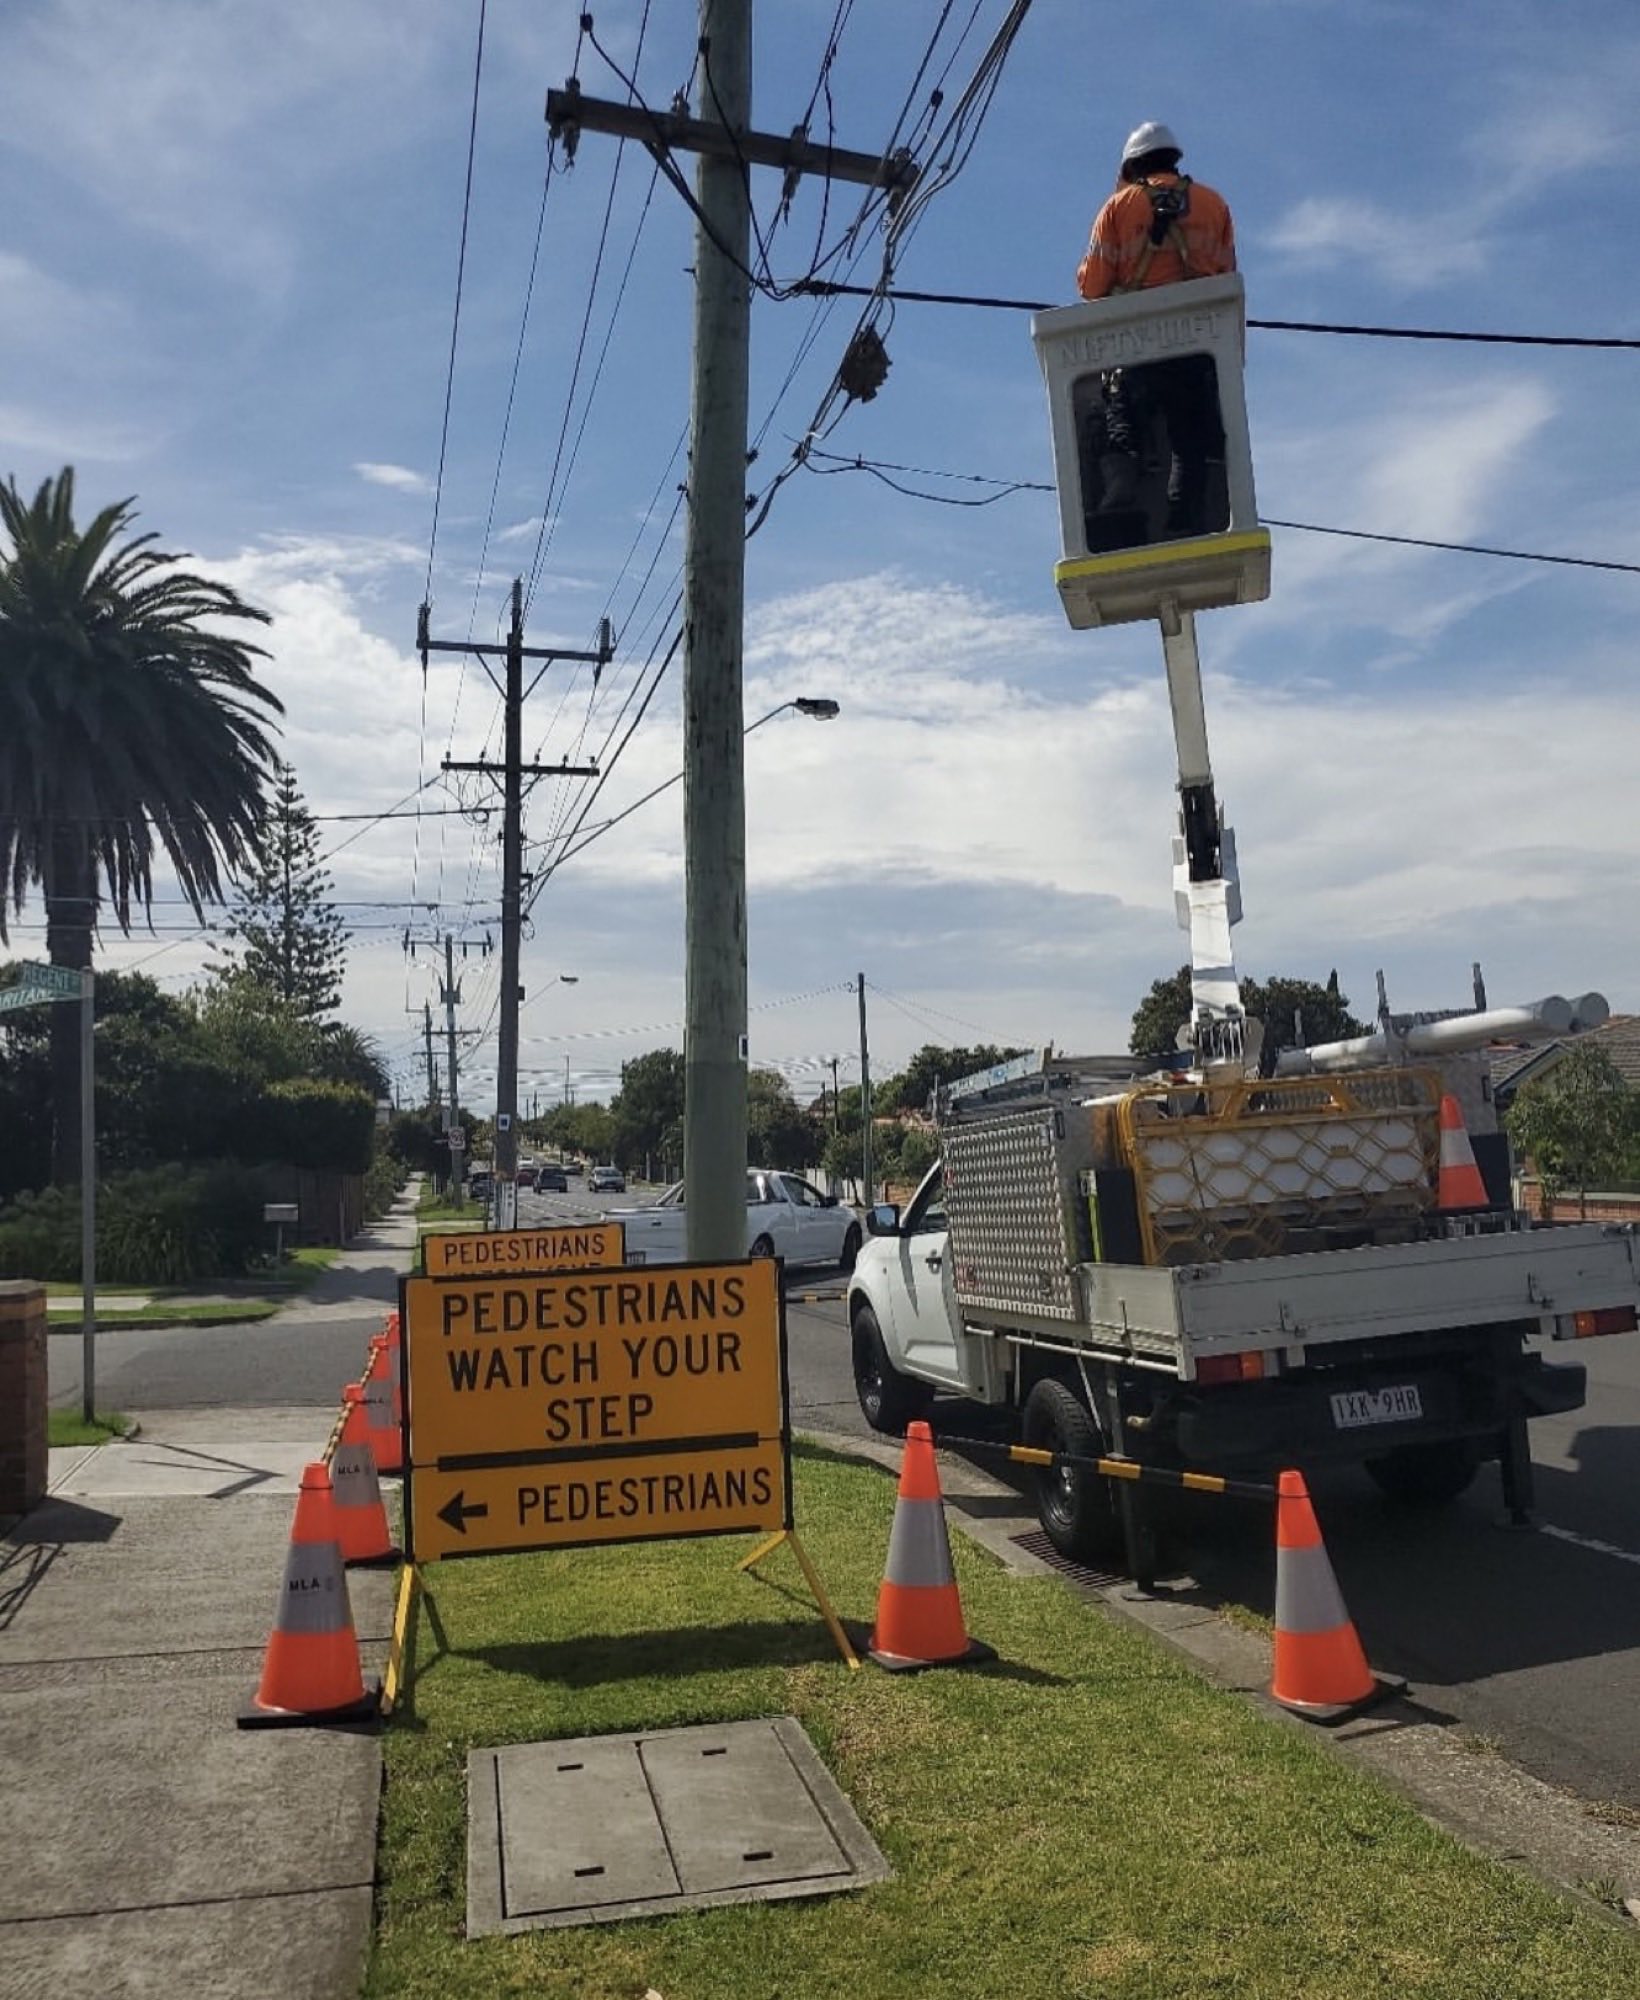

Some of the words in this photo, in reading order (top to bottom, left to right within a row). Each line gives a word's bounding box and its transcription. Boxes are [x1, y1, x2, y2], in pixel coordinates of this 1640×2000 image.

[444, 1233, 605, 1265] PEDESTRIANS
[442, 1276, 745, 1336] PEDESTRIANS
[448, 1340, 599, 1392] WATCH
[622, 1332, 743, 1380] YOUR
[546, 1393, 653, 1441] STEP
[518, 1467, 772, 1525] PEDESTRIANS
[289, 1577, 320, 1591] MLA
